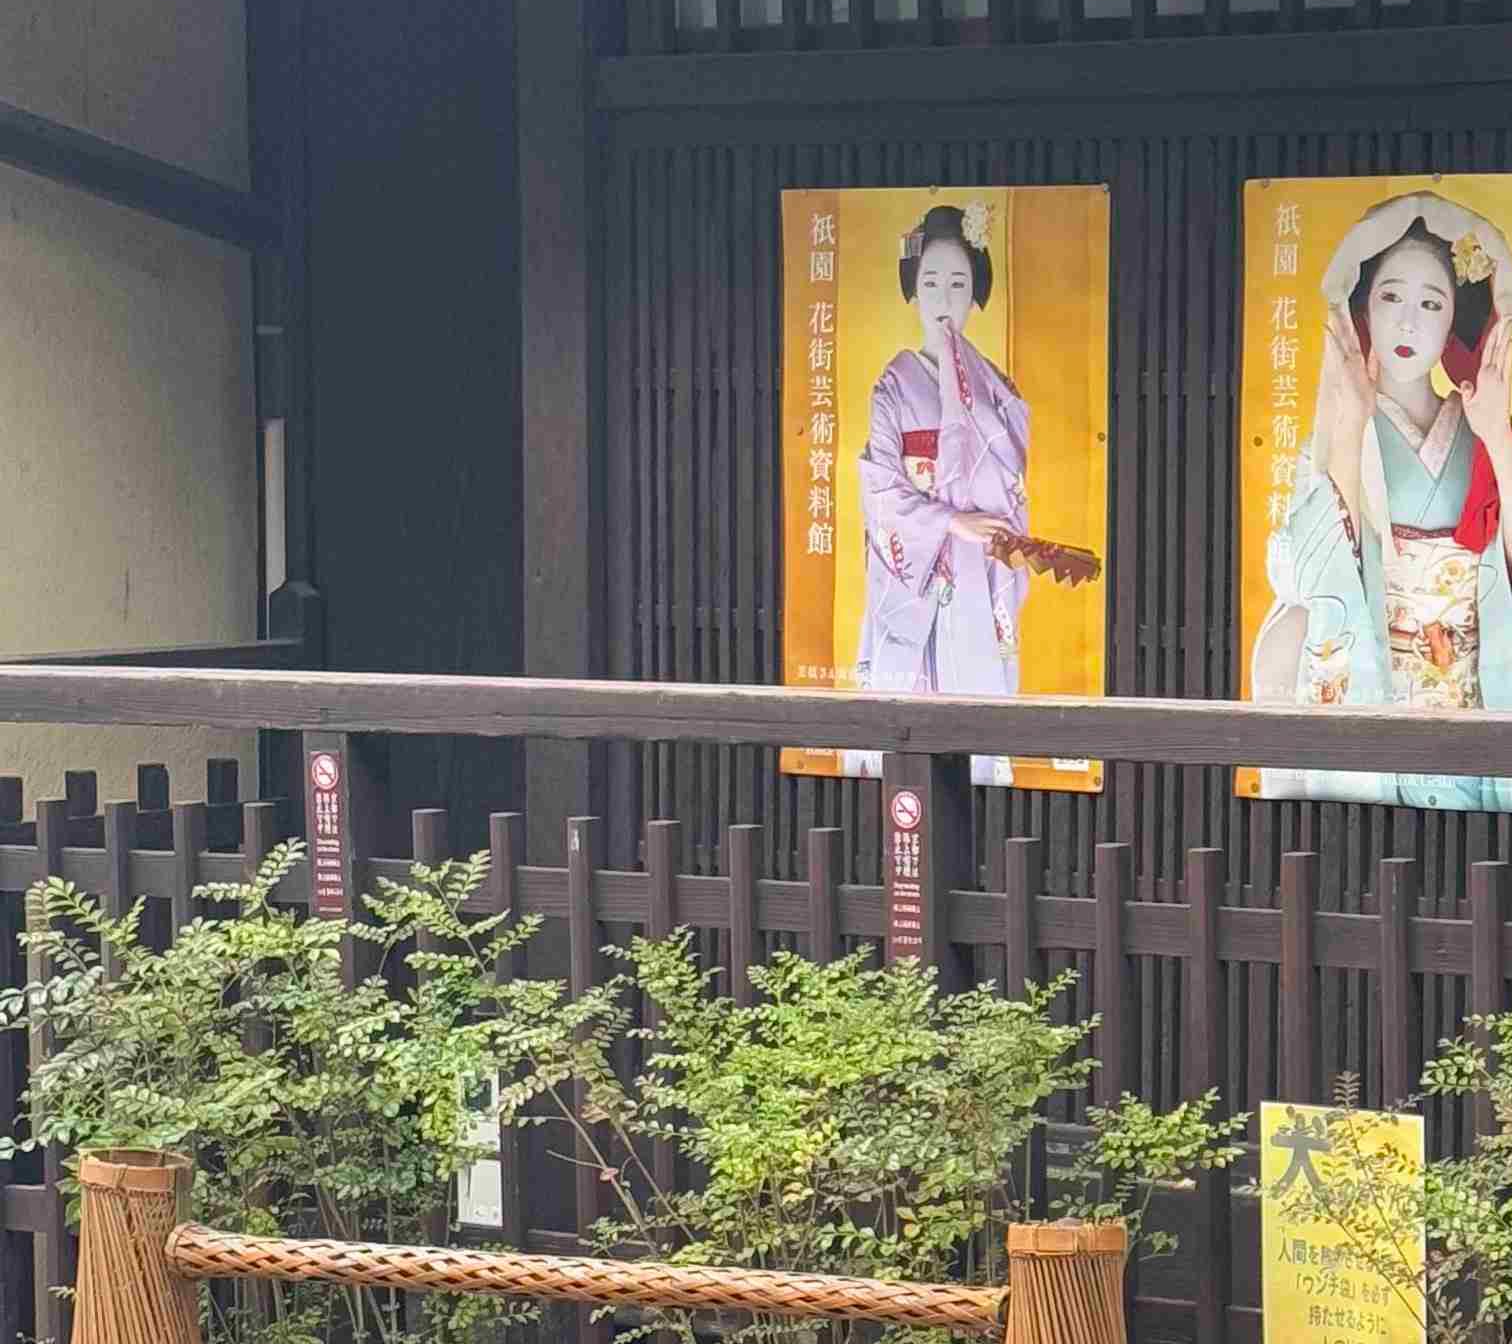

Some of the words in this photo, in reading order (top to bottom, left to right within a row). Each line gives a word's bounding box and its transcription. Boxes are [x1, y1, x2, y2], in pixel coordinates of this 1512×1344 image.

[809, 214, 835, 282] 祇園
[1273, 203, 1300, 277] 祇園
[806, 302, 835, 556] 花街芸術資料館
